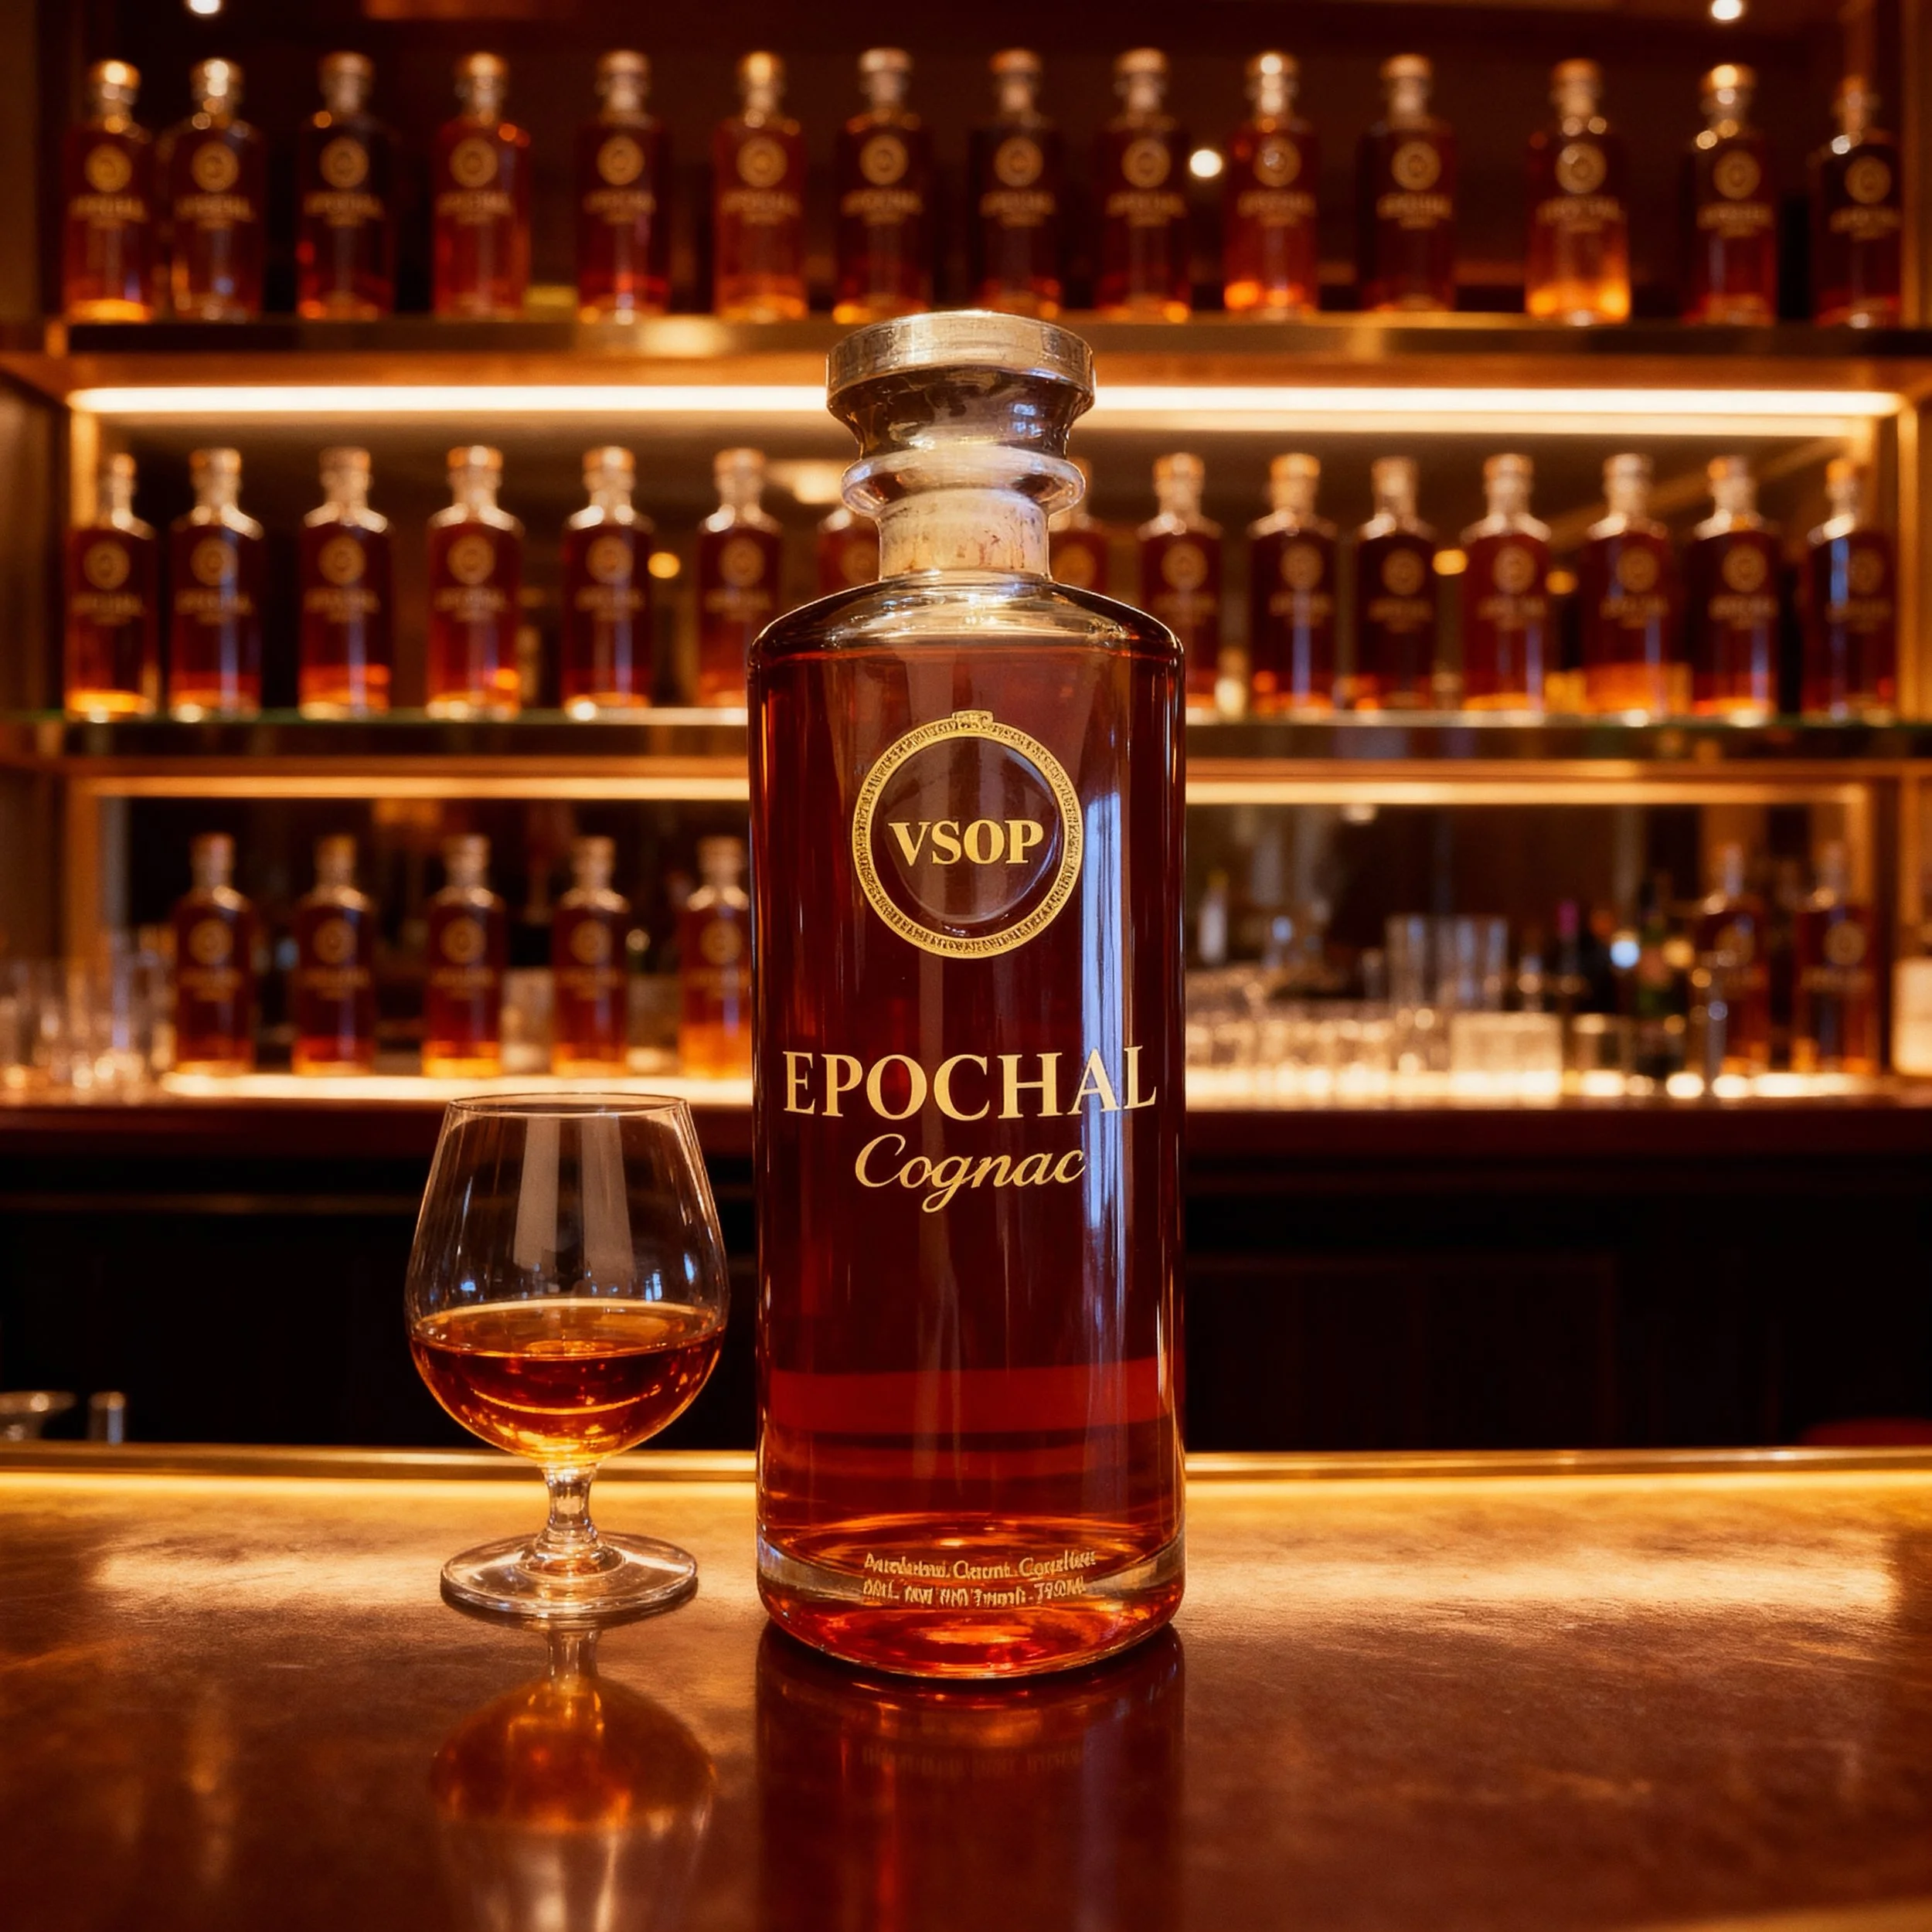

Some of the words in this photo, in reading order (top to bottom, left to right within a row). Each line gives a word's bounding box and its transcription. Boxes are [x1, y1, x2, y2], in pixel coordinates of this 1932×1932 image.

[889, 820, 1043, 866] VSOP
[784, 1046, 1157, 1121] EPOCHAL
[856, 1134, 1086, 1213] Cognac
